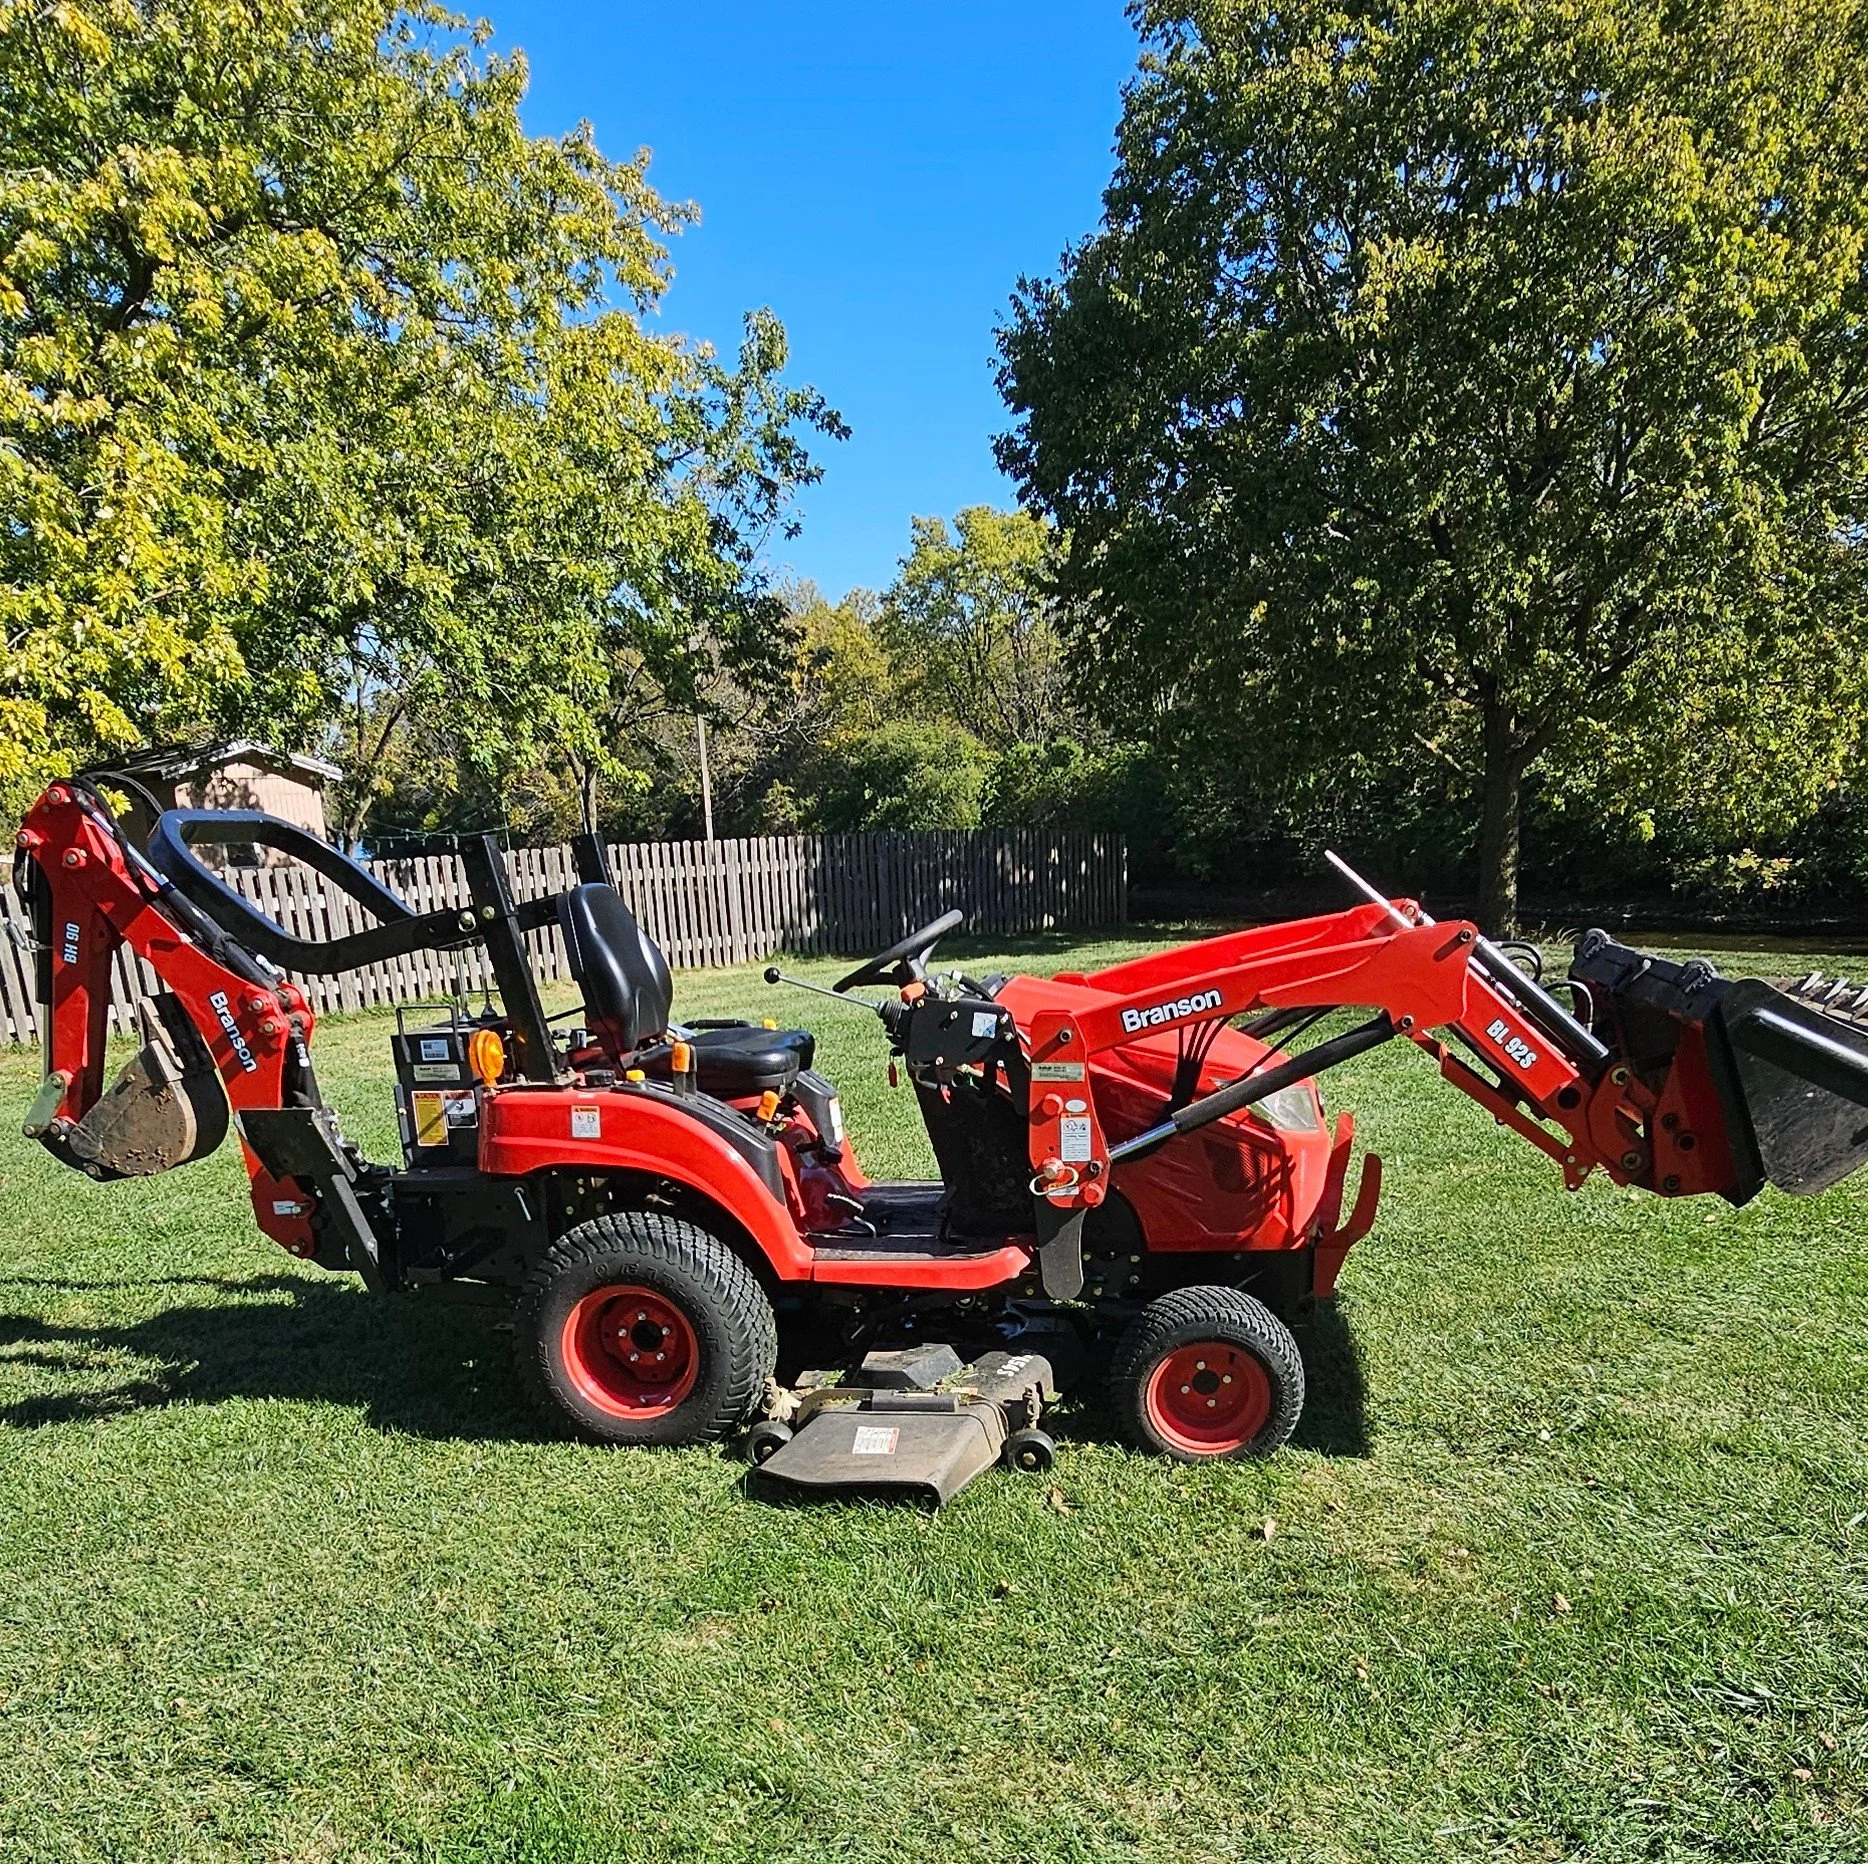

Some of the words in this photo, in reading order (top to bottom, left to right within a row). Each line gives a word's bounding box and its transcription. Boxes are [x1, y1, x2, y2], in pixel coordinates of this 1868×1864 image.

[64, 942, 78, 964] BH
[66, 922, 80, 942] 90
[209, 991, 257, 1073] Branson
[1122, 989, 1222, 1033] Branson
[1486, 1019, 1510, 1045] BL
[1504, 1037, 1537, 1069] 92S
